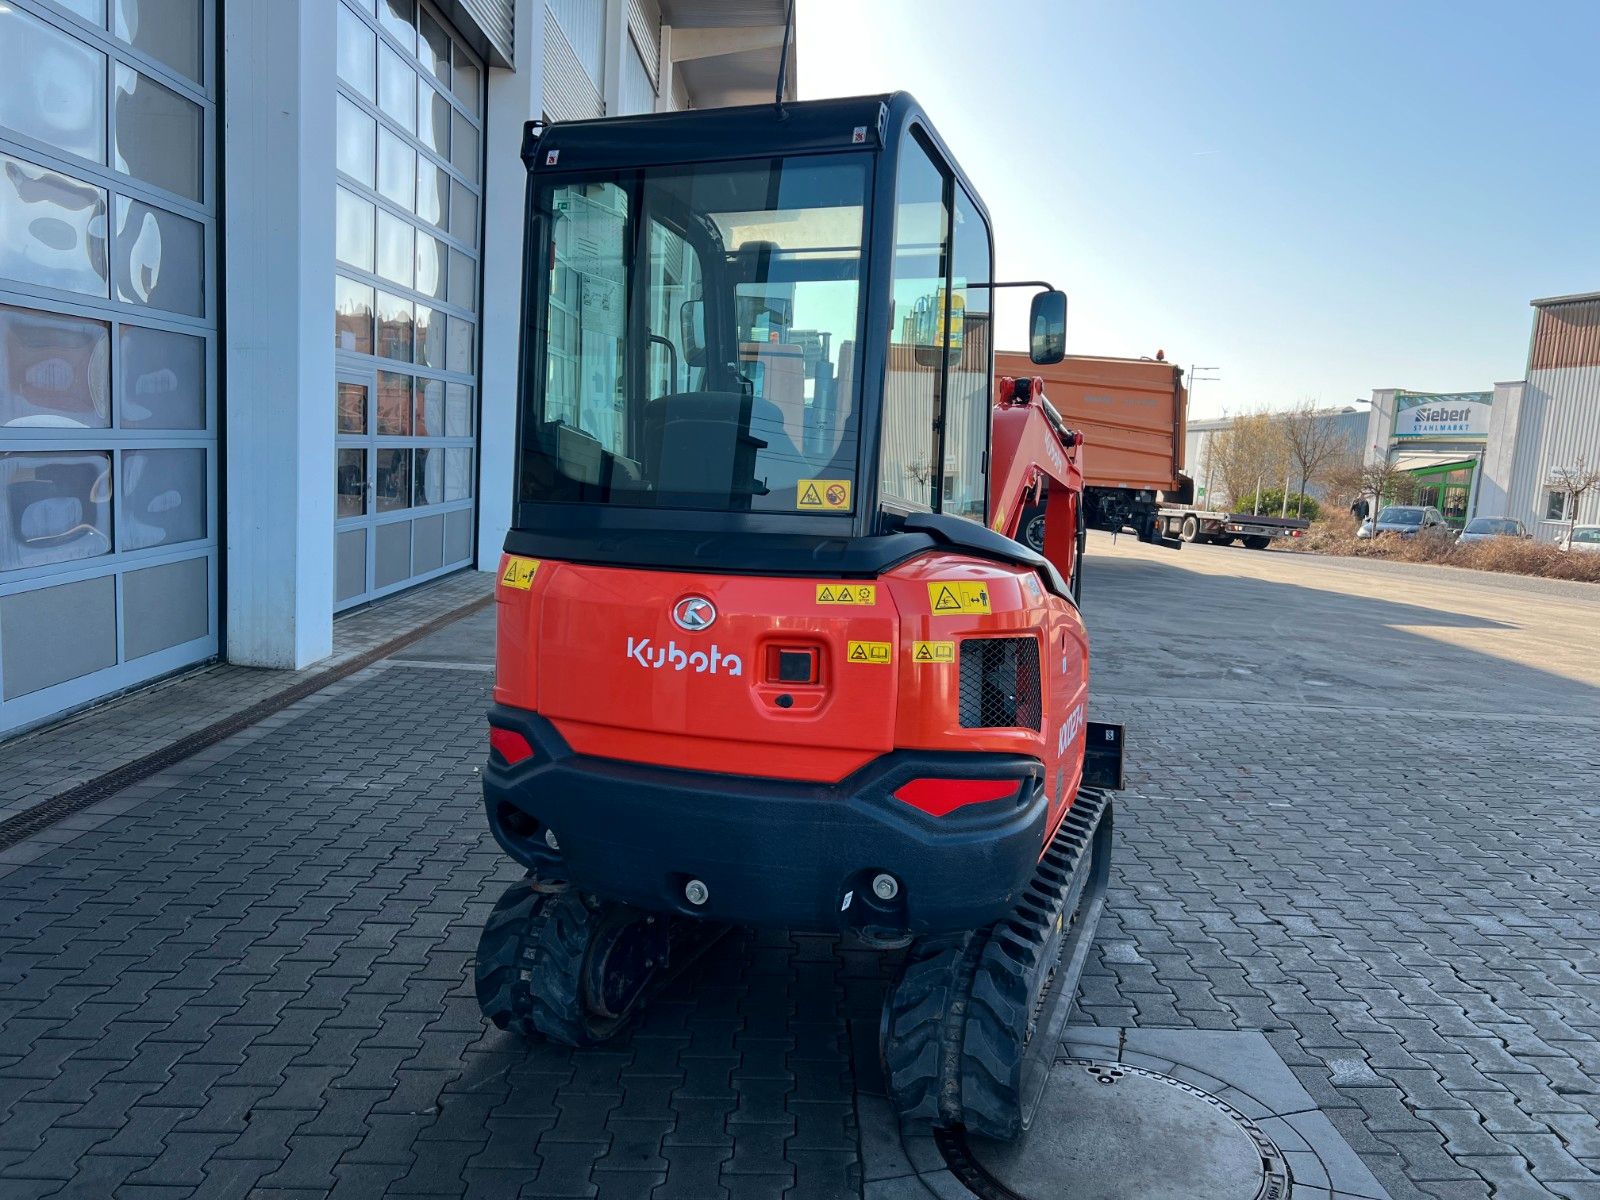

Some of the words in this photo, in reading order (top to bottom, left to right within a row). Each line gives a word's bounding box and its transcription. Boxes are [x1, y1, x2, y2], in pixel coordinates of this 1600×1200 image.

[1415, 407, 1471, 422] Siebert
[1413, 424, 1470, 432] STAHLMARKT
[626, 636, 742, 676] Kubota
